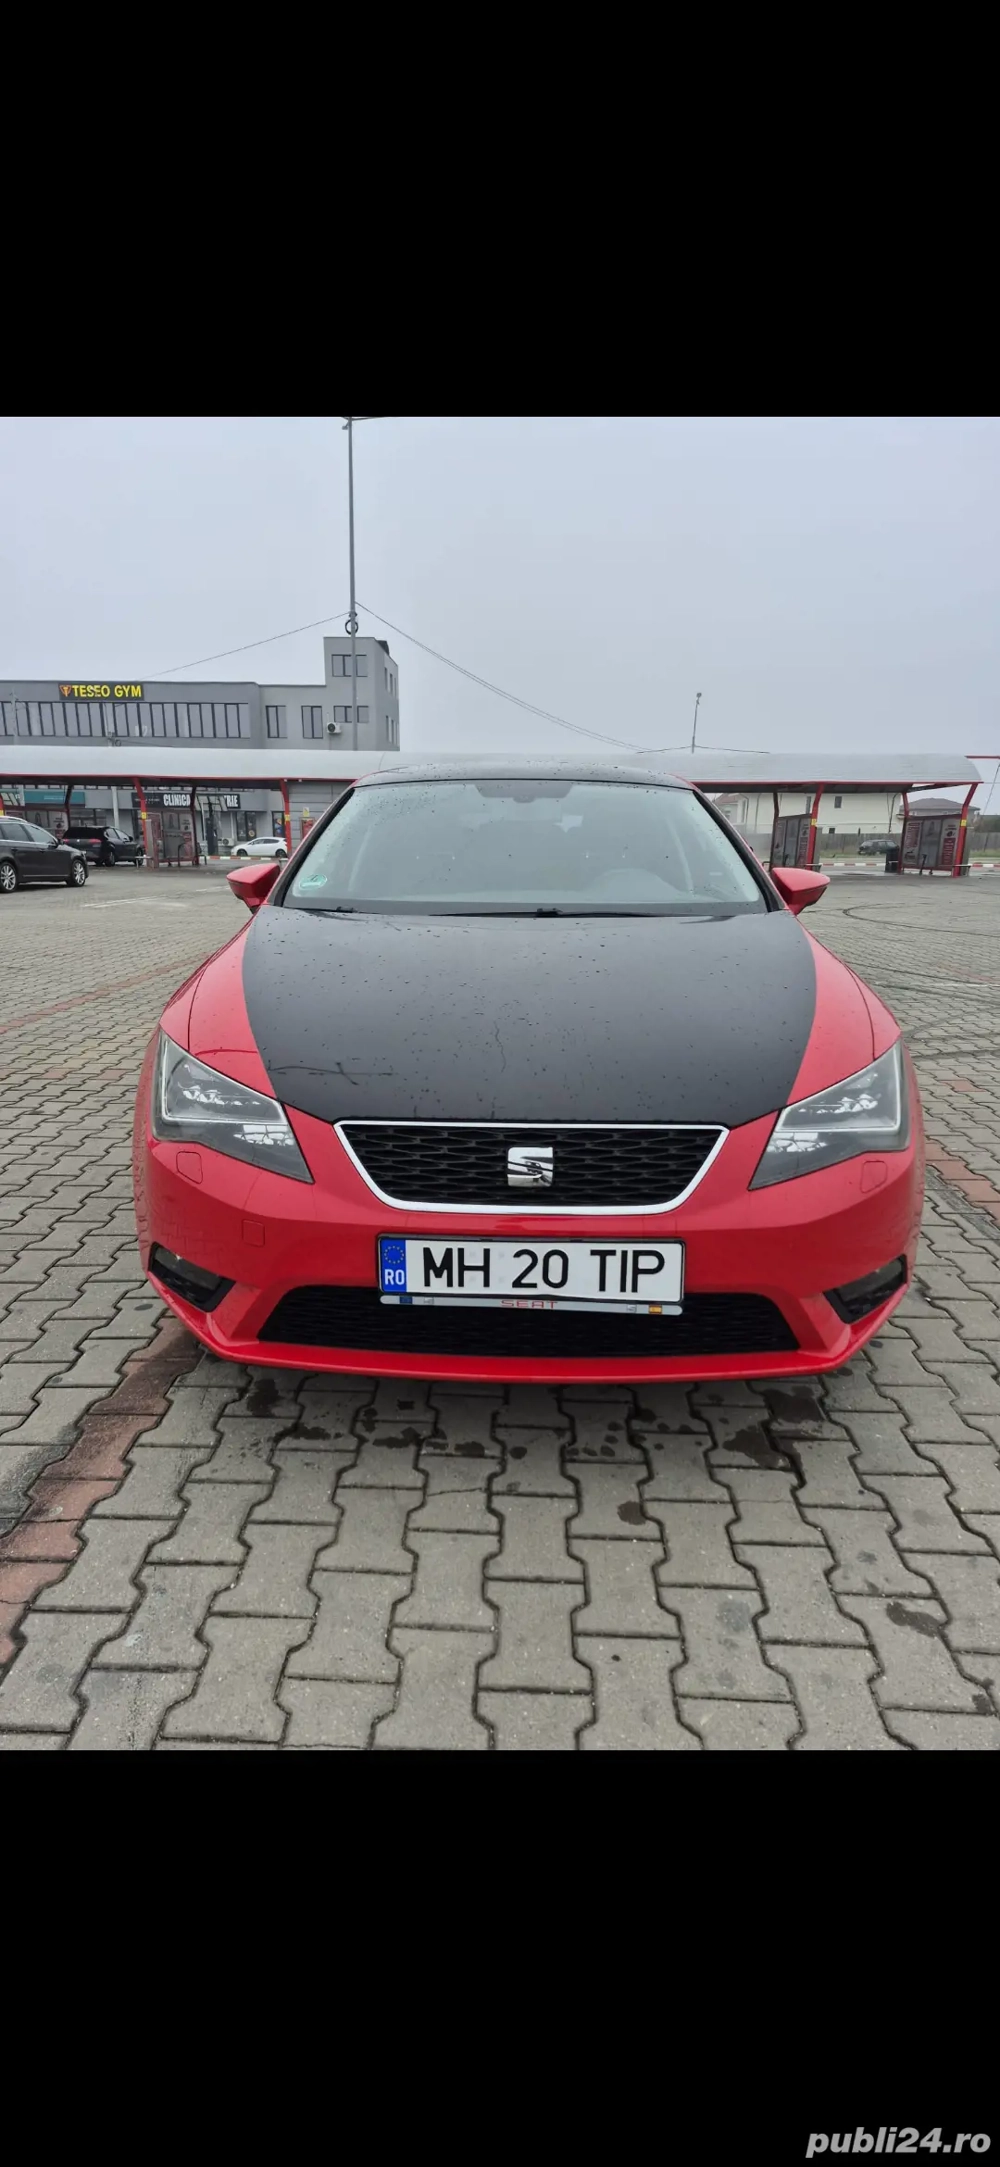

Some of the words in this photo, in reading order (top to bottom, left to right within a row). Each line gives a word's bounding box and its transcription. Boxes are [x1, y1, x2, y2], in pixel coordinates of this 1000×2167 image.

[72, 685, 110, 697] TESEO
[114, 685, 141, 698] GYM
[384, 1269, 405, 1285] RO
[423, 1247, 490, 1288] MH
[512, 1249, 569, 1289] 20
[590, 1249, 665, 1293] TIP
[501, 1299, 558, 1309] SEAT
